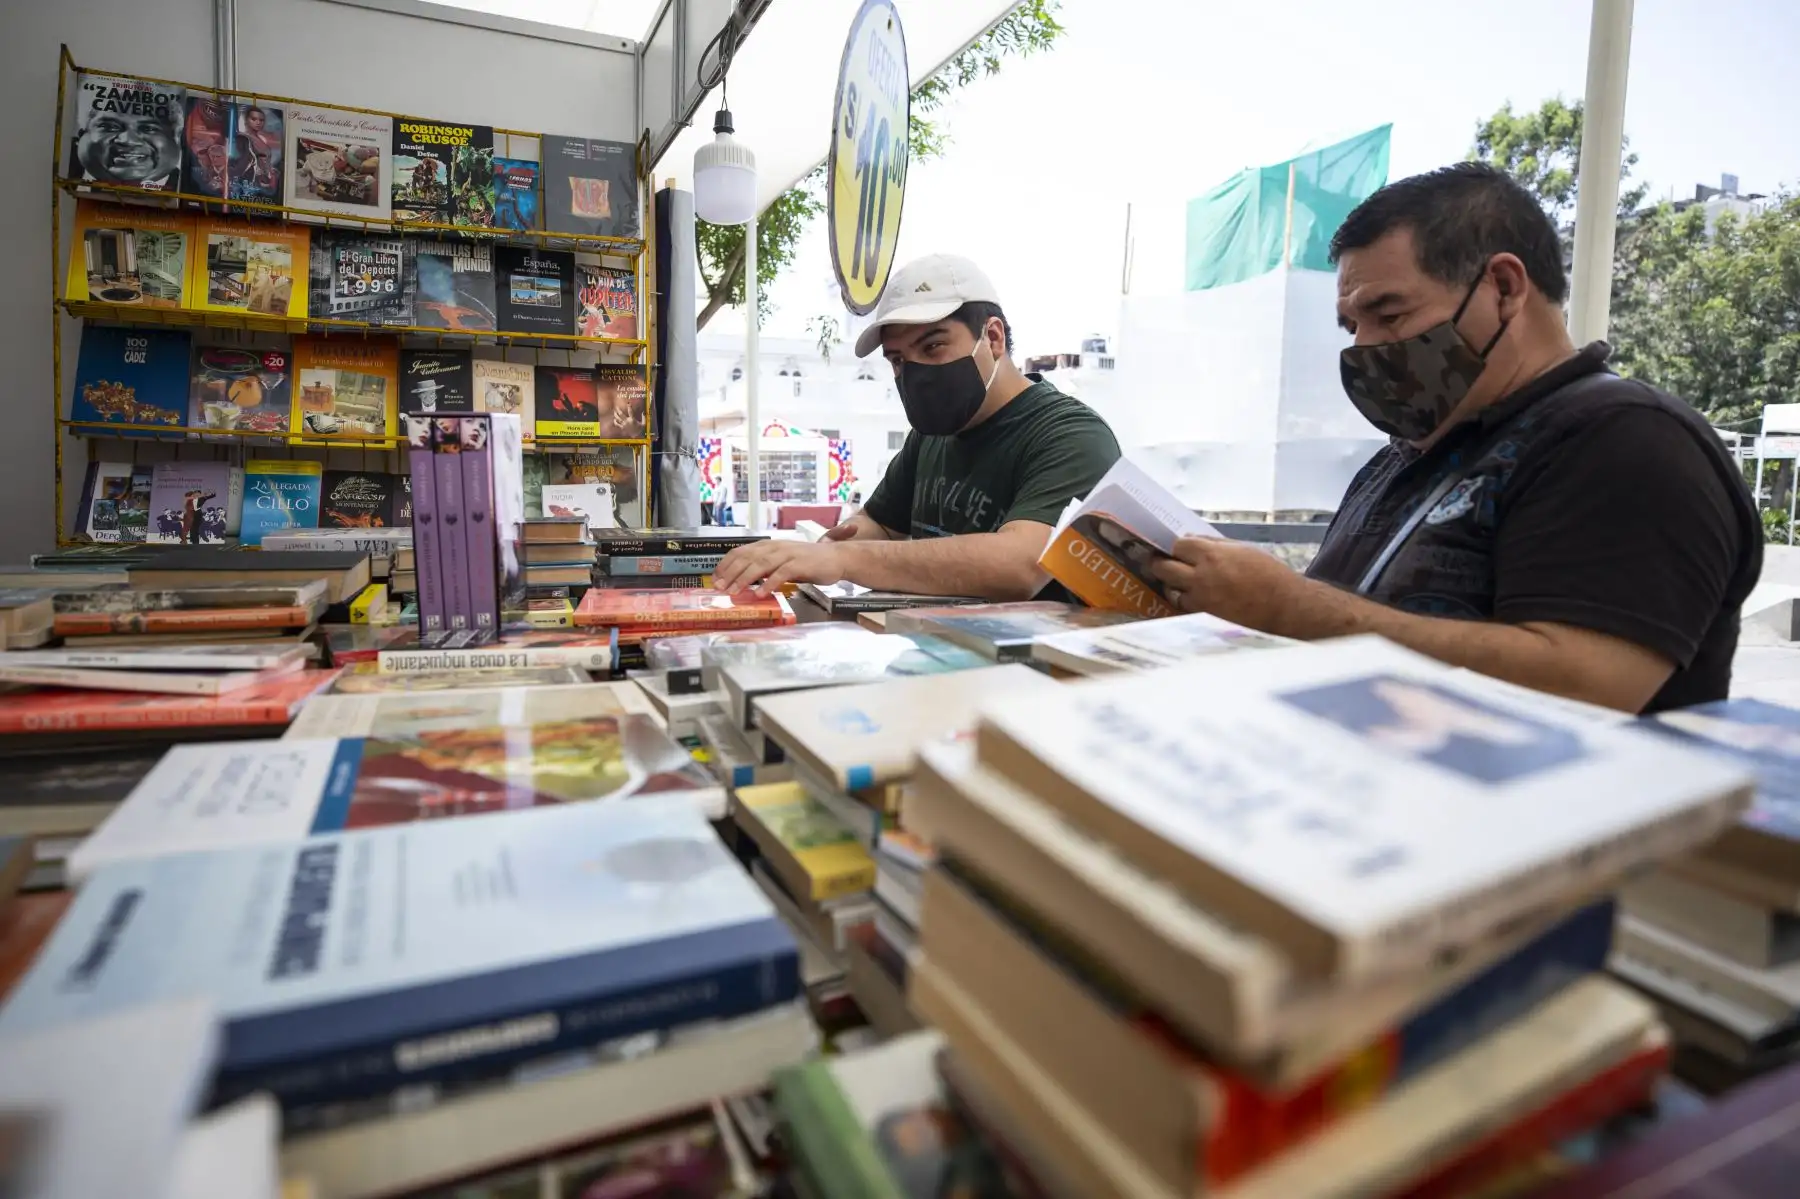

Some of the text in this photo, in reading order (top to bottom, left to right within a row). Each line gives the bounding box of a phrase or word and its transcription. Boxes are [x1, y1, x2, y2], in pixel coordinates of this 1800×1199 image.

[868, 28, 899, 113] OFERTA
[92, 98, 169, 119] CAVERO
[400, 123, 473, 138] ROBINSON
[400, 143, 425, 151] Daniel
[411, 134, 469, 146] CRUSOE
[340, 250, 396, 265] El Gran Libro
[523, 256, 561, 271] España,
[340, 263, 396, 276] del Deporte
[453, 258, 491, 273] MUNDO
[340, 279, 394, 295] 1996
[587, 275, 596, 285] LA
[616, 279, 626, 289] DE
[126, 338, 148, 348] 100
[354, 540, 389, 552] CAZA
[1067, 539, 1146, 610] VALLEJO
[635, 611, 664, 622] SEXO
[385, 651, 465, 671] inquietante
[470, 653, 506, 666] duda
[509, 653, 528, 666] La
